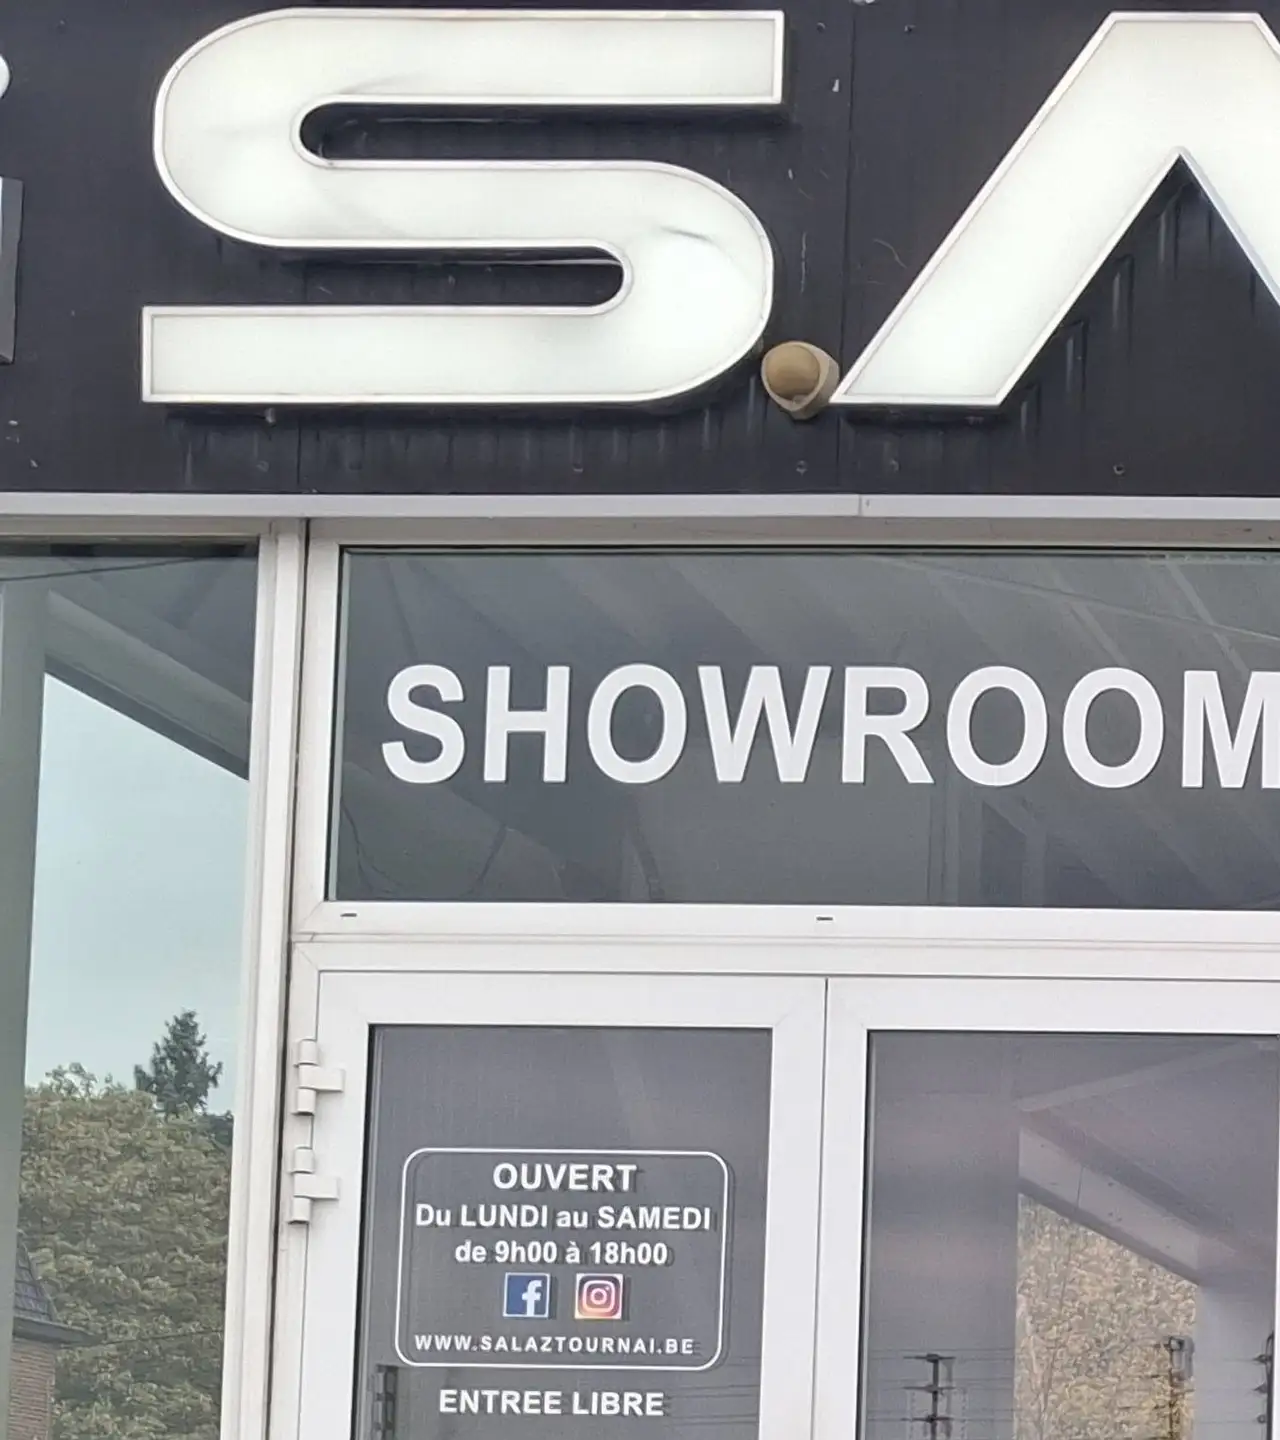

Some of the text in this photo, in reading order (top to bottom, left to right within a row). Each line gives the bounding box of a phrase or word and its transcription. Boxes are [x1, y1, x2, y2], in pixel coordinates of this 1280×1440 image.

[492, 1162, 638, 1192] OUVERT
[415, 1203, 711, 1231] Du LUNDI au SAMEDI
[455, 1240, 669, 1265] de 9h00 à 18h00
[414, 1334, 695, 1355] WWW.SALAZTOURNAI.BE
[438, 1388, 665, 1417] ENTREE LIBRE
